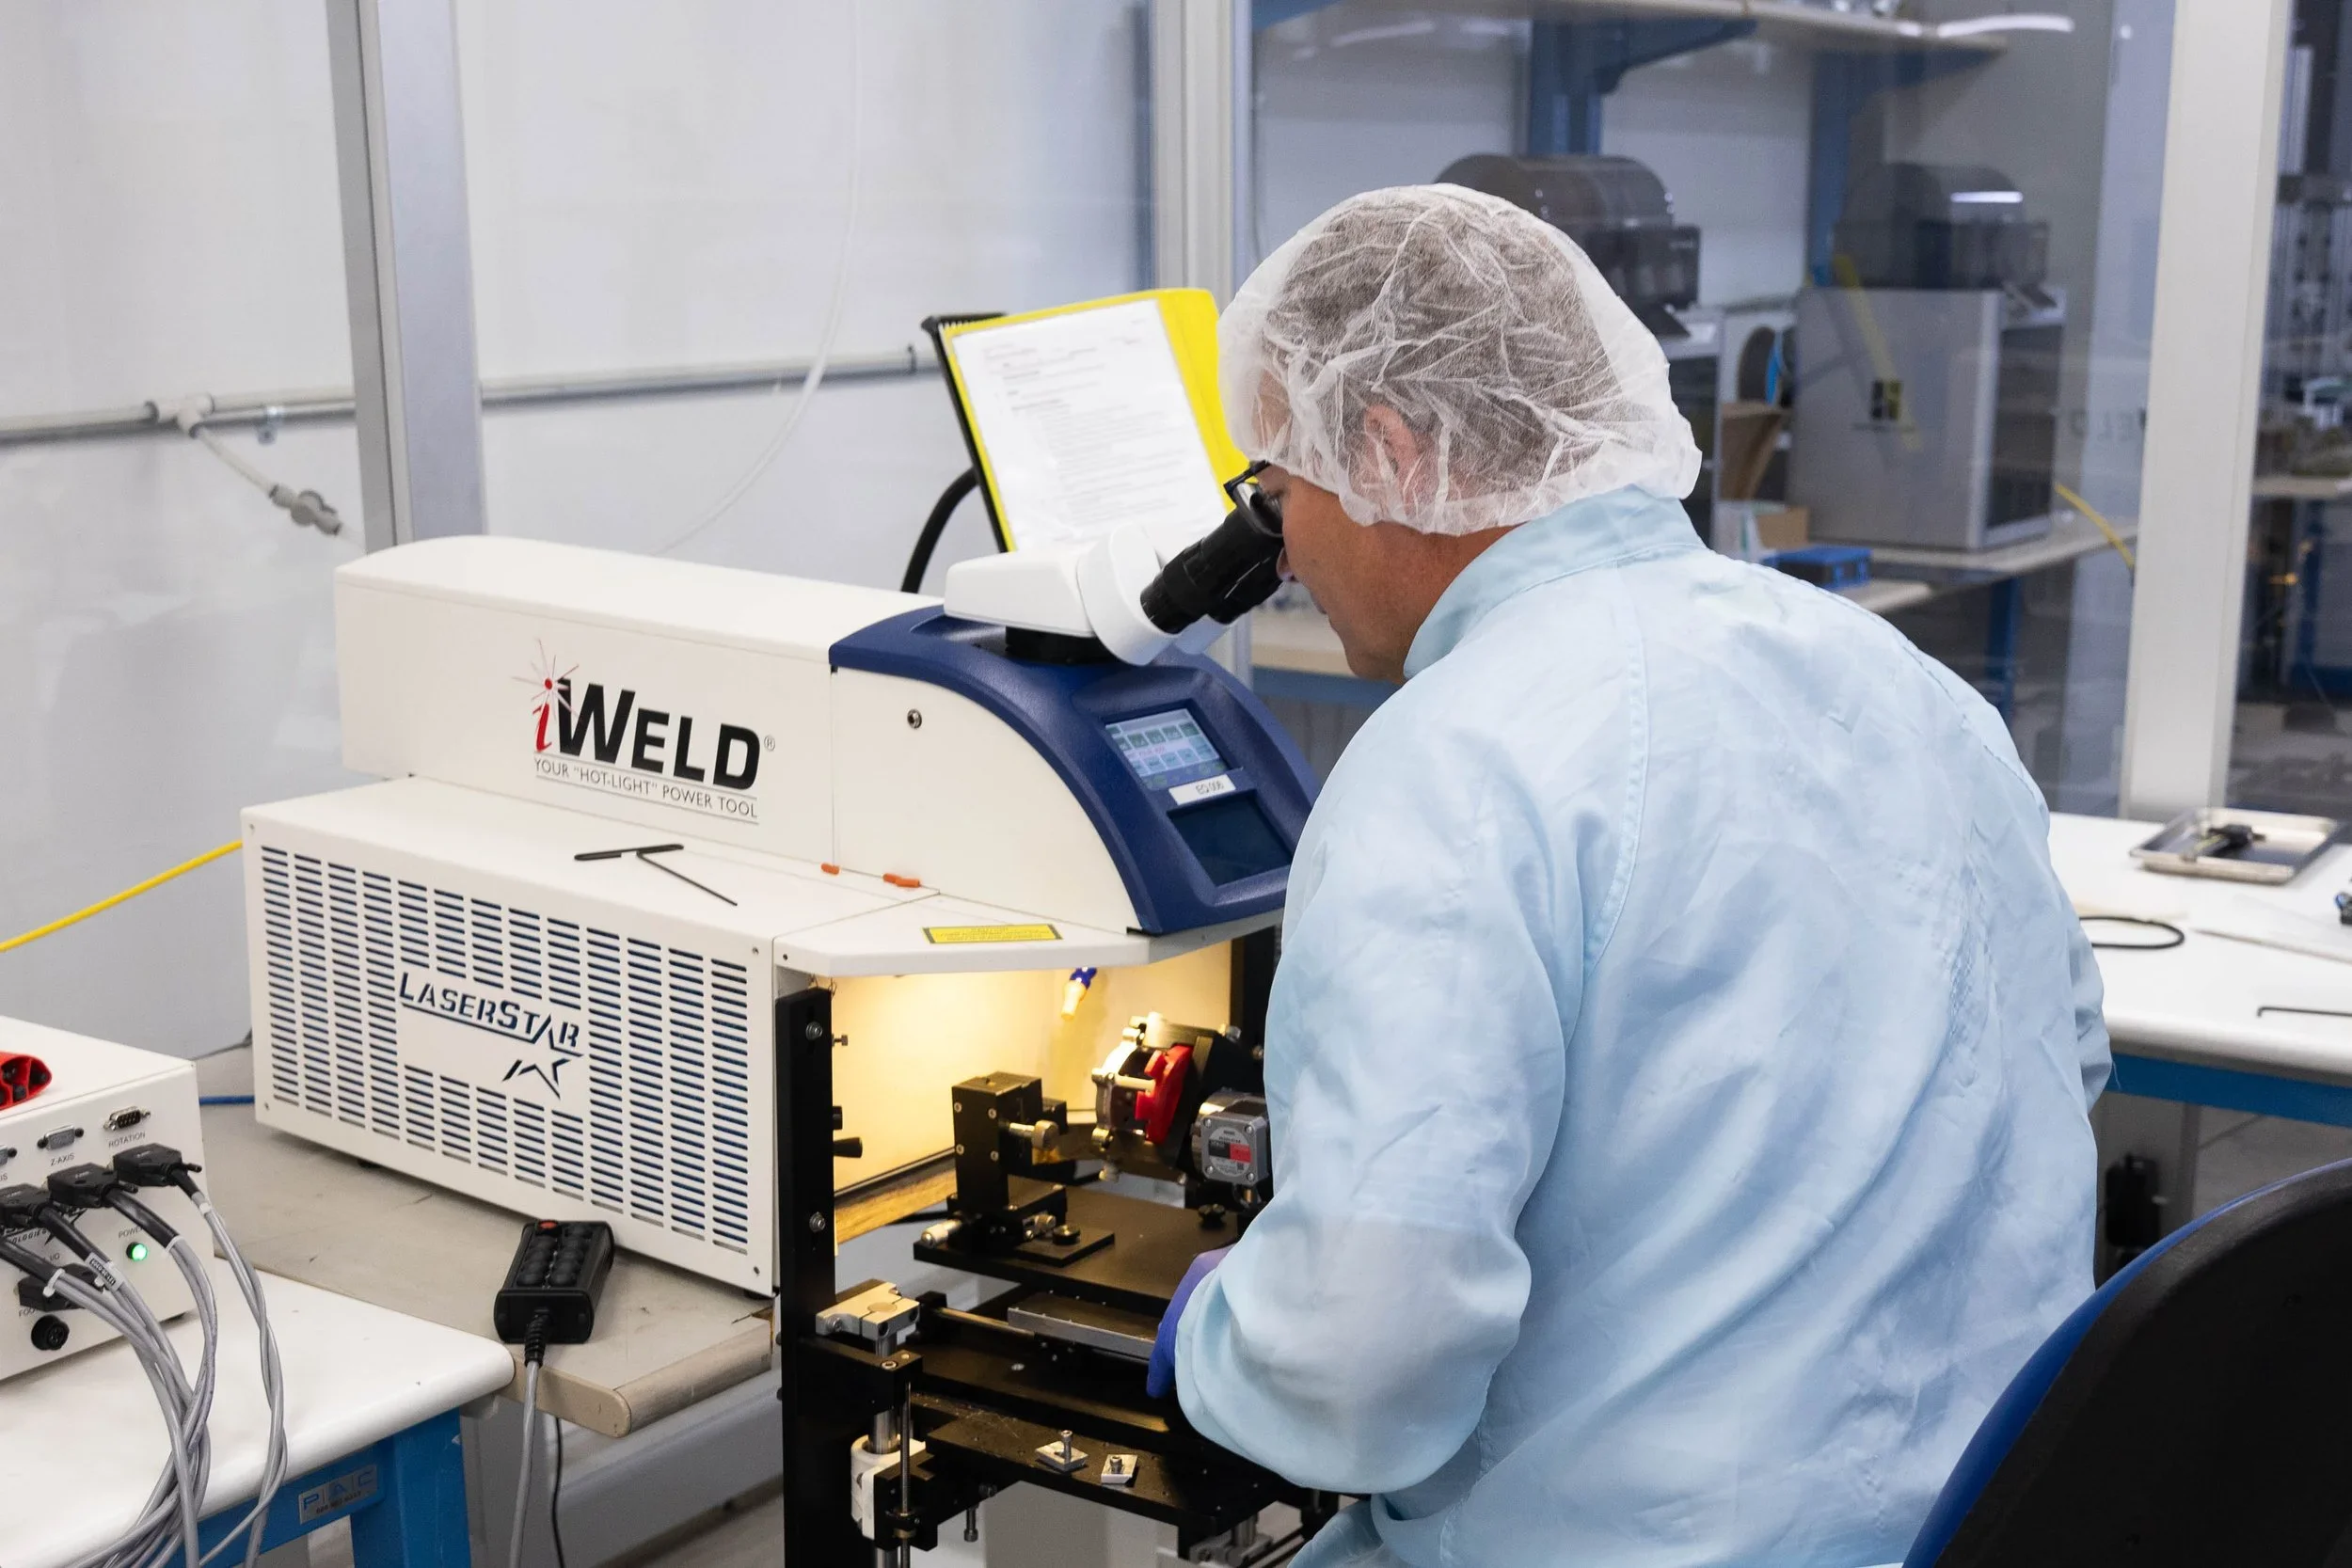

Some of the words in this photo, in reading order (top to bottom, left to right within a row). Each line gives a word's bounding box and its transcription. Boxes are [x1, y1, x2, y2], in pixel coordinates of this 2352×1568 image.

[533, 756, 570, 776] YOUR
[662, 784, 713, 809] POWER
[718, 795, 758, 818] TOOL
[399, 972, 580, 1049] LASERSTAR
[51, 1152, 75, 1167] Z-AXIS
[108, 1132, 146, 1148] ROTATION
